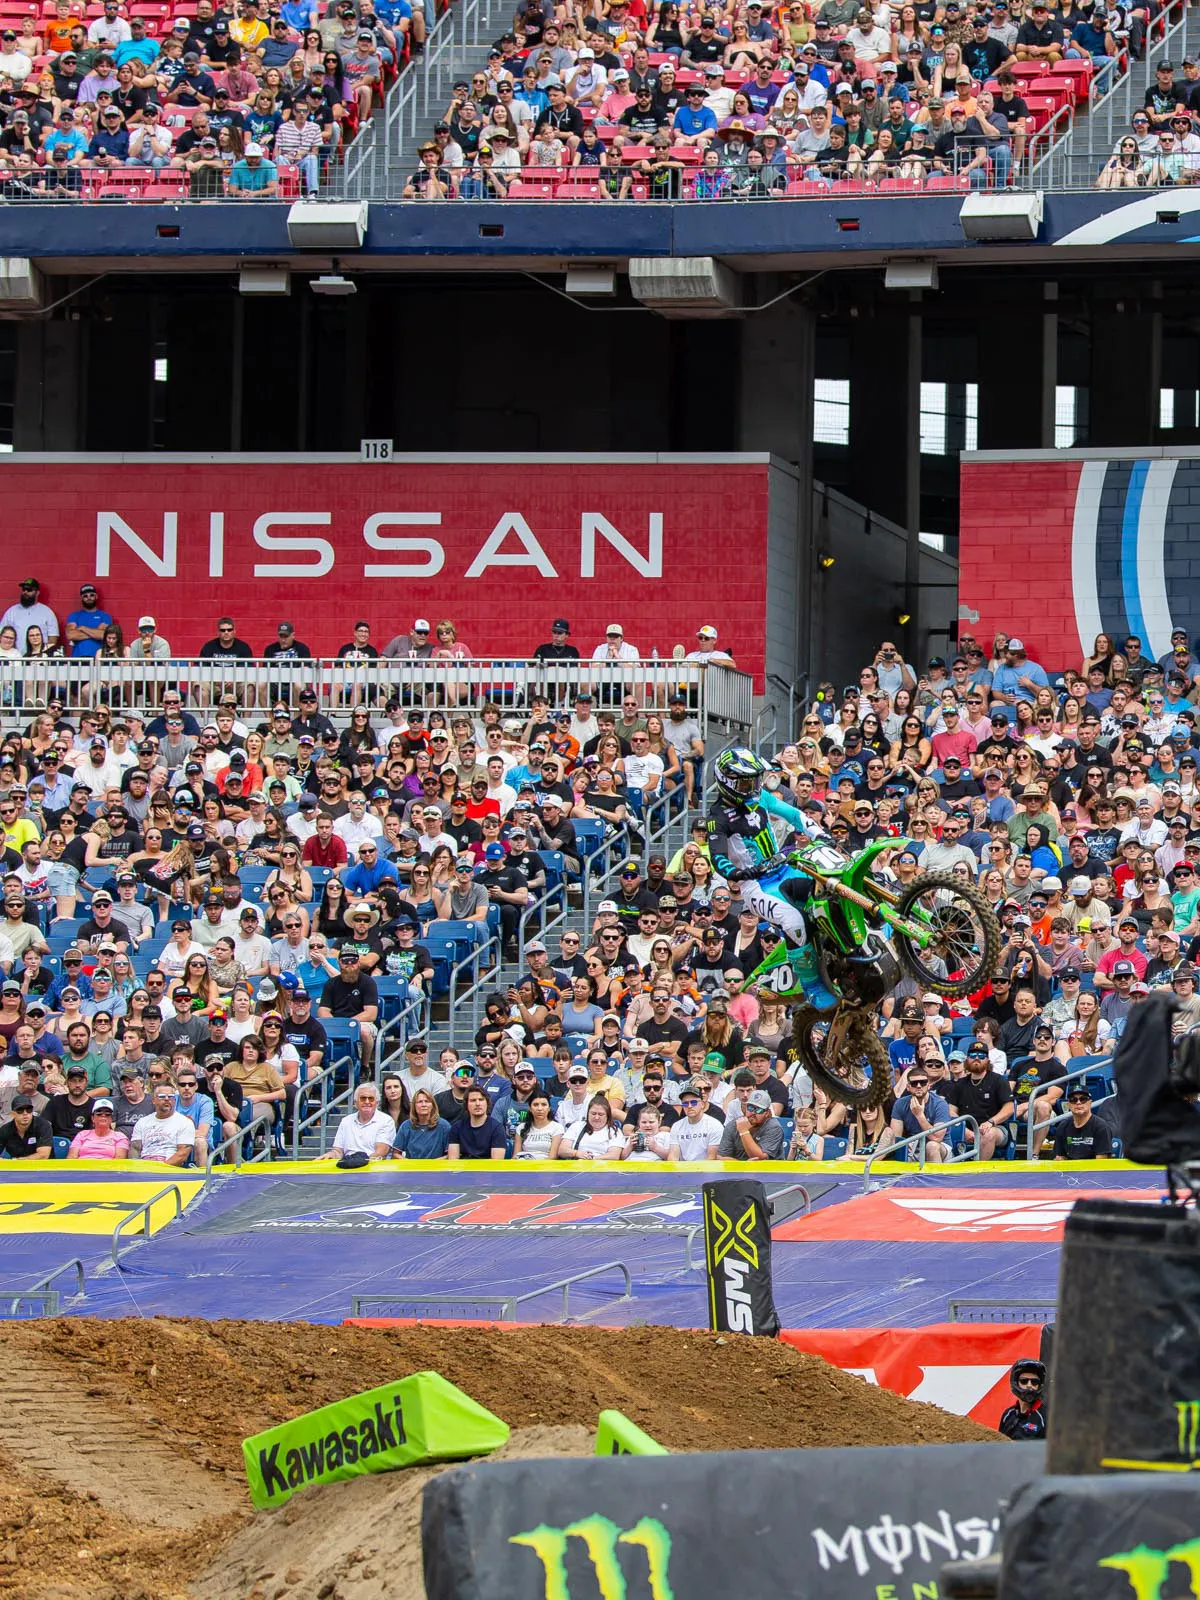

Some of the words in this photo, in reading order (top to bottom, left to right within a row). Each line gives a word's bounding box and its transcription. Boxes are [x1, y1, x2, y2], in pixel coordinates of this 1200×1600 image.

[364, 442, 390, 459] 118
[95, 511, 664, 578] NISSAN
[809, 845, 847, 870] 10
[770, 964, 794, 992] 10
[249, 1220, 375, 1229] AMERICAN
[259, 1395, 408, 1497] Kawasaki
